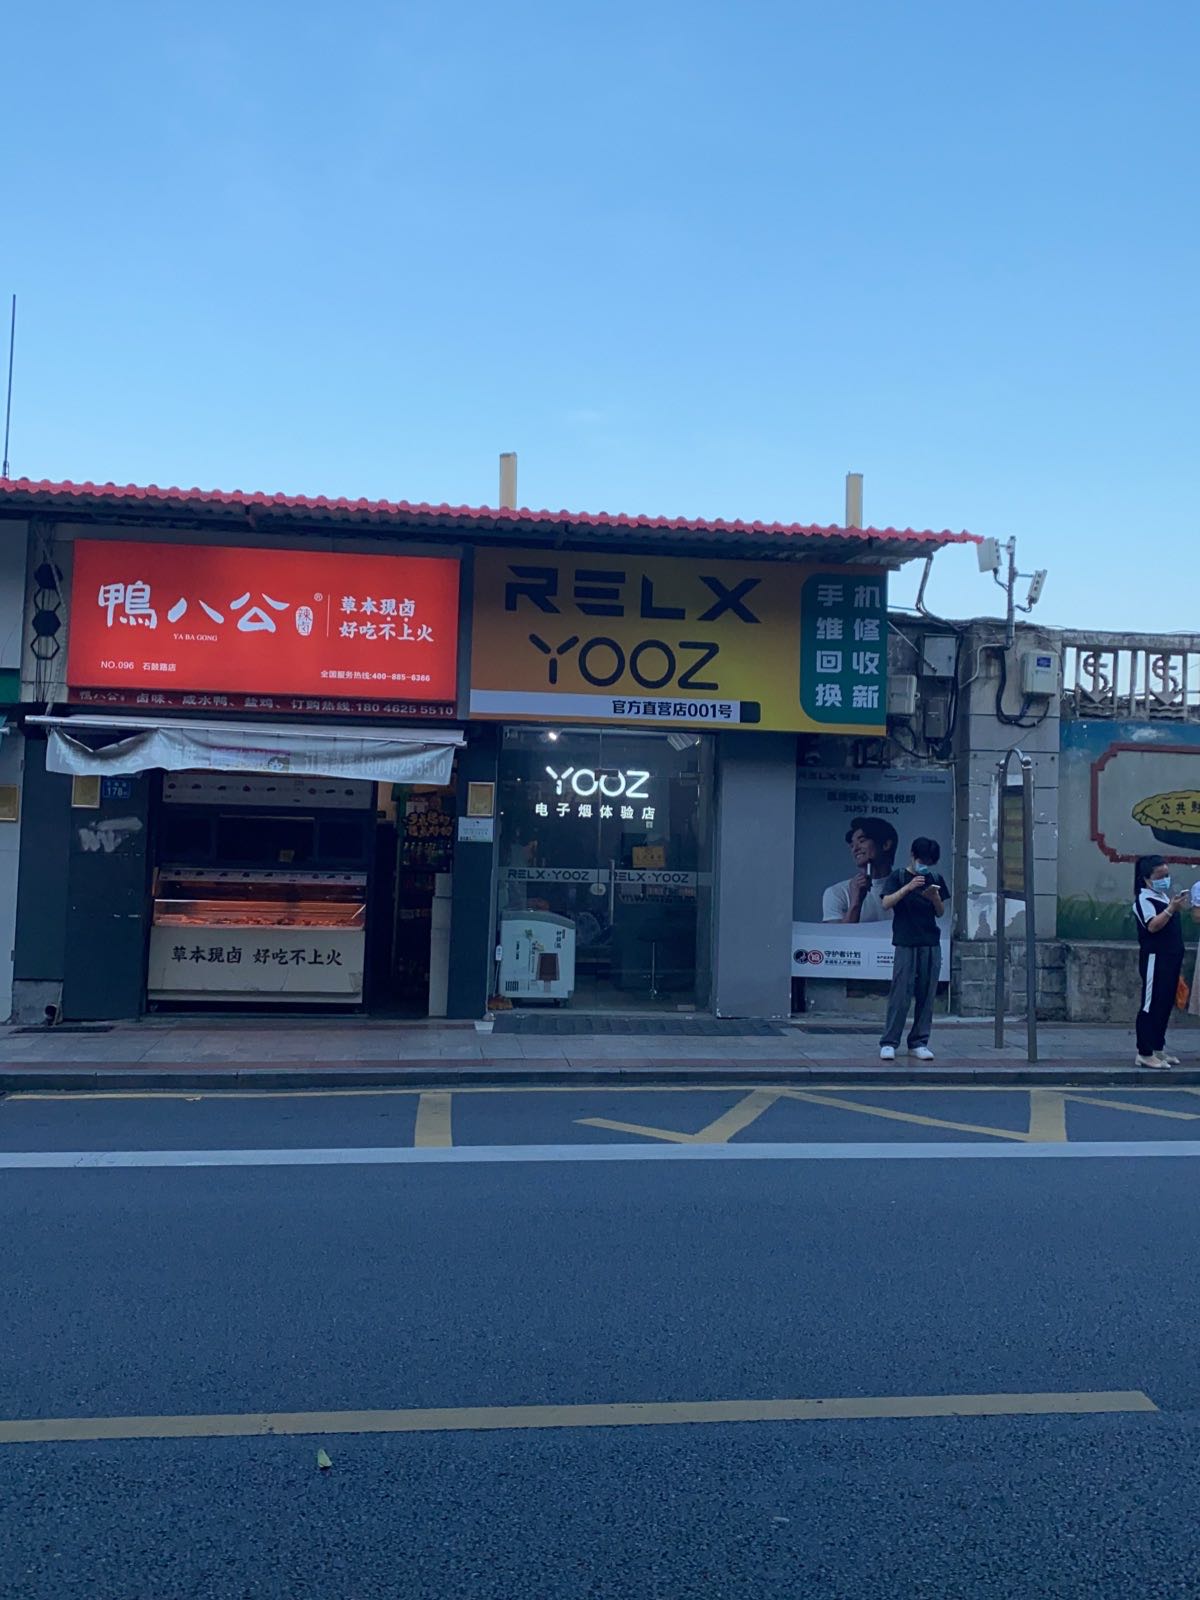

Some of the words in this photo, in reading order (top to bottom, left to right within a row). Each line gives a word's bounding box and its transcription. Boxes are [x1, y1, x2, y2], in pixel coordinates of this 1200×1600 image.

[505, 565, 763, 624] RELX
[816, 584, 881, 609] 手机
[173, 632, 184, 641] YA
[185, 633, 196, 641] BA
[196, 634, 218, 642] GONG
[339, 620, 434, 642] 好吃不上火
[816, 618, 881, 642] 维修
[100, 660, 135, 670] NO.096
[528, 633, 720, 690] YOOZ
[815, 650, 880, 676] 回收
[815, 683, 880, 709] 换新
[612, 699, 733, 719] 官方直营店001号
[545, 765, 650, 798] YOOZ
[535, 802, 656, 820] 电子烟体验店
[871, 806, 900, 815] RELX
[253, 949, 343, 966] 好吃不上火
